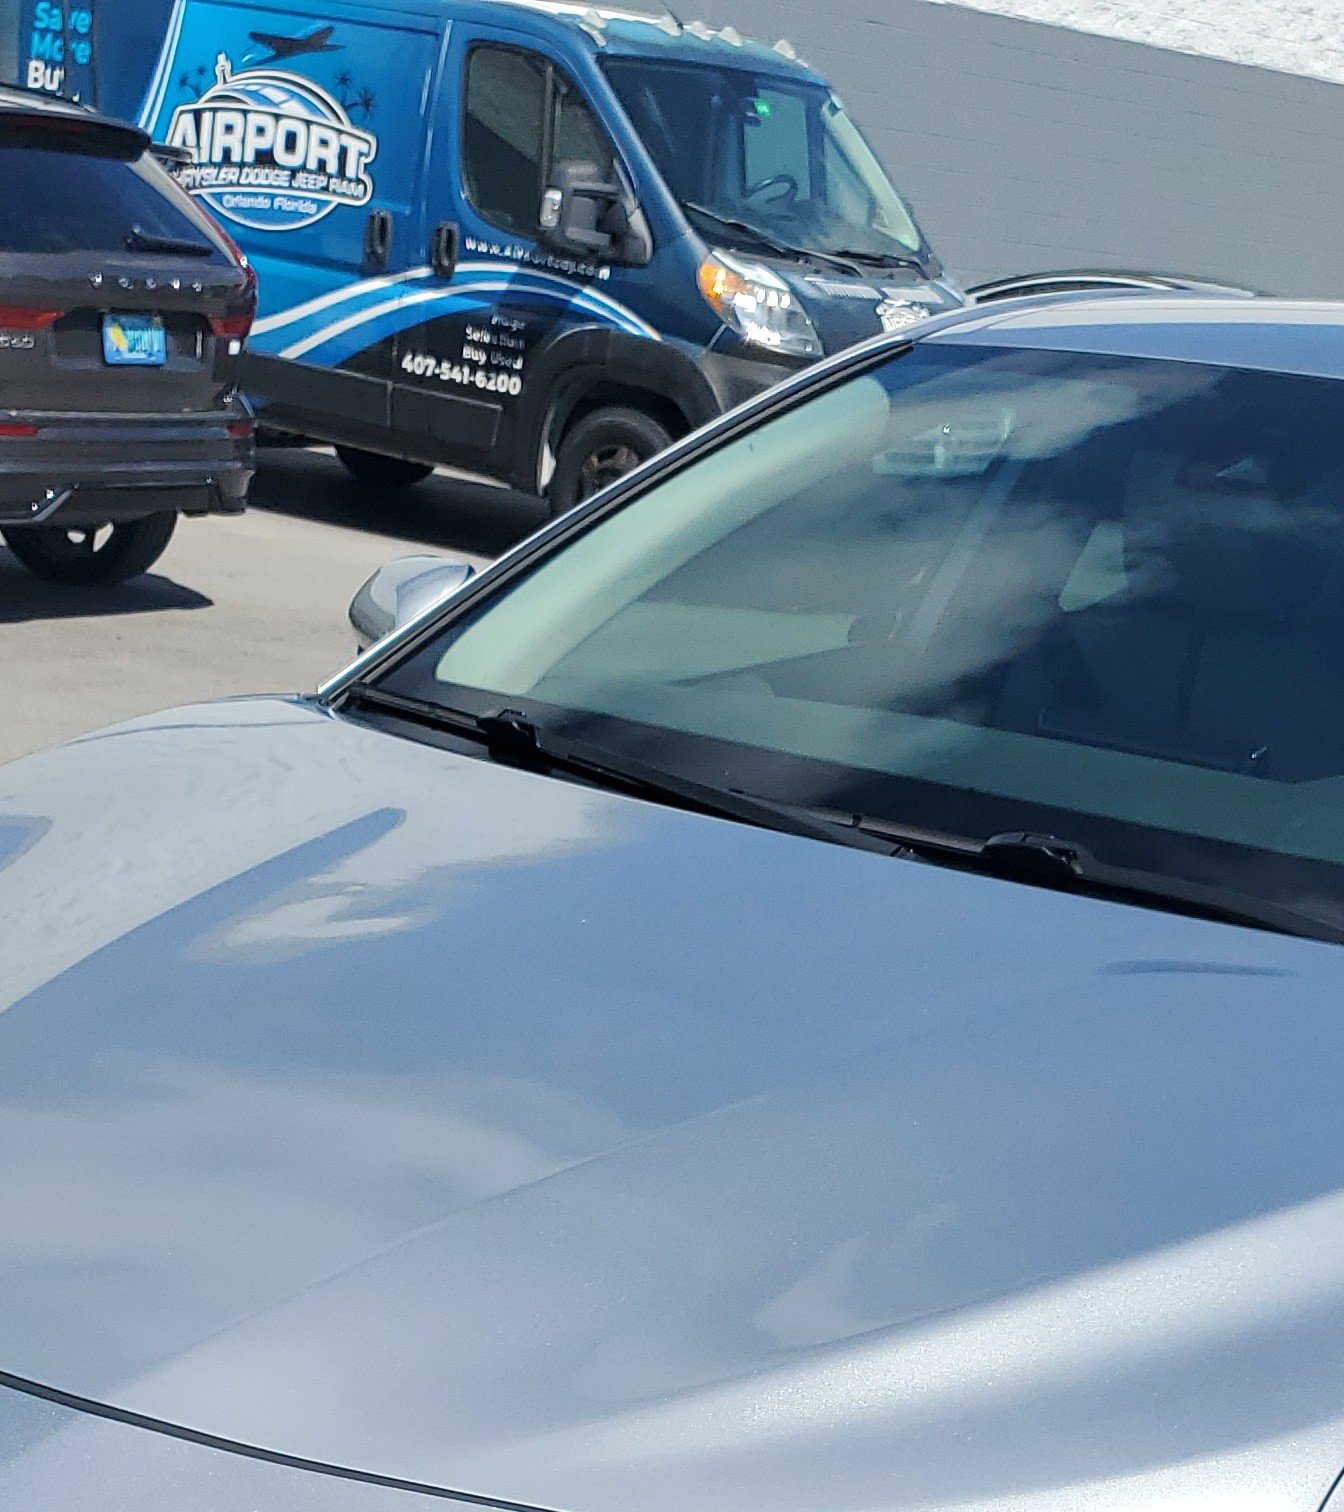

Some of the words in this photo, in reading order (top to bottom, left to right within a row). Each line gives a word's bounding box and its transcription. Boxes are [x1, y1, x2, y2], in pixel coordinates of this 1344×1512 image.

[171, 109, 370, 179] AIRPORT
[172, 165, 240, 188] RYSLER
[239, 167, 292, 187] DODGE
[291, 172, 329, 190] JEEP
[328, 177, 365, 198] RAM
[401, 353, 523, 395] 407-541-6200
[462, 345, 487, 366] Buy
